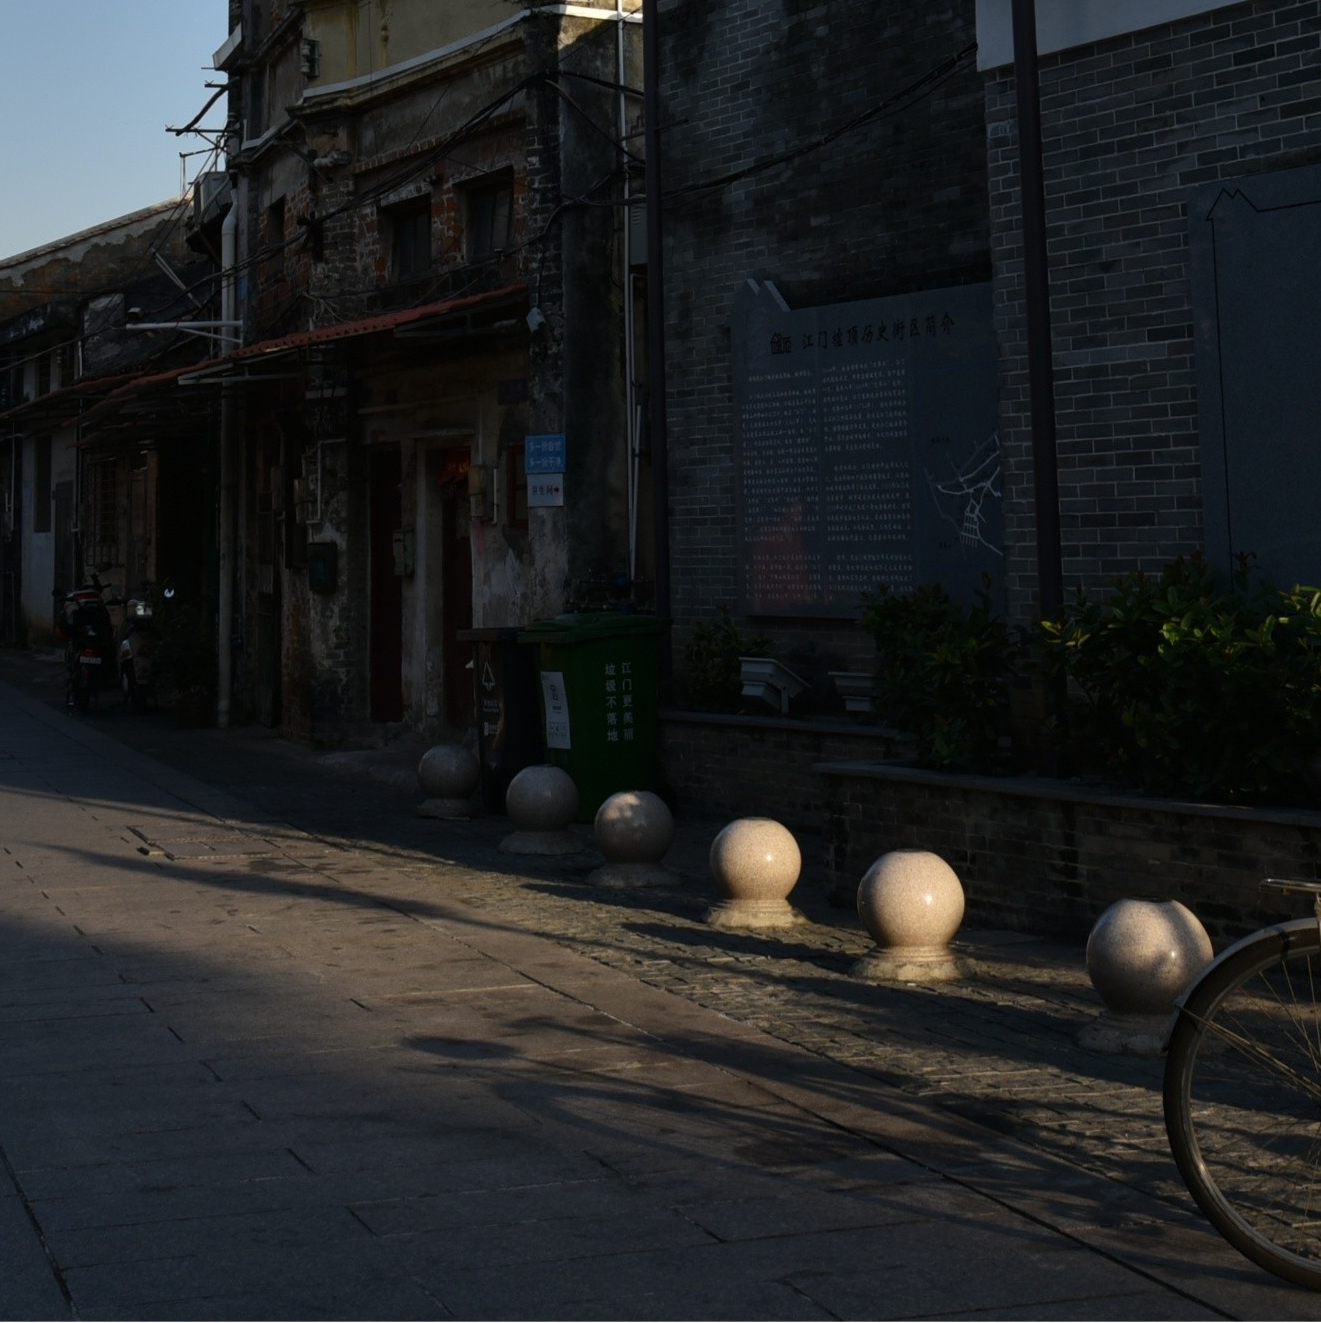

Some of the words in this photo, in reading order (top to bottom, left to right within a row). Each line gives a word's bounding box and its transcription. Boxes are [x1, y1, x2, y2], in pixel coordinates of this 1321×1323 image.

[605, 663, 619, 742] 垃圾不落地
[621, 662, 634, 741] 江门更美丽
